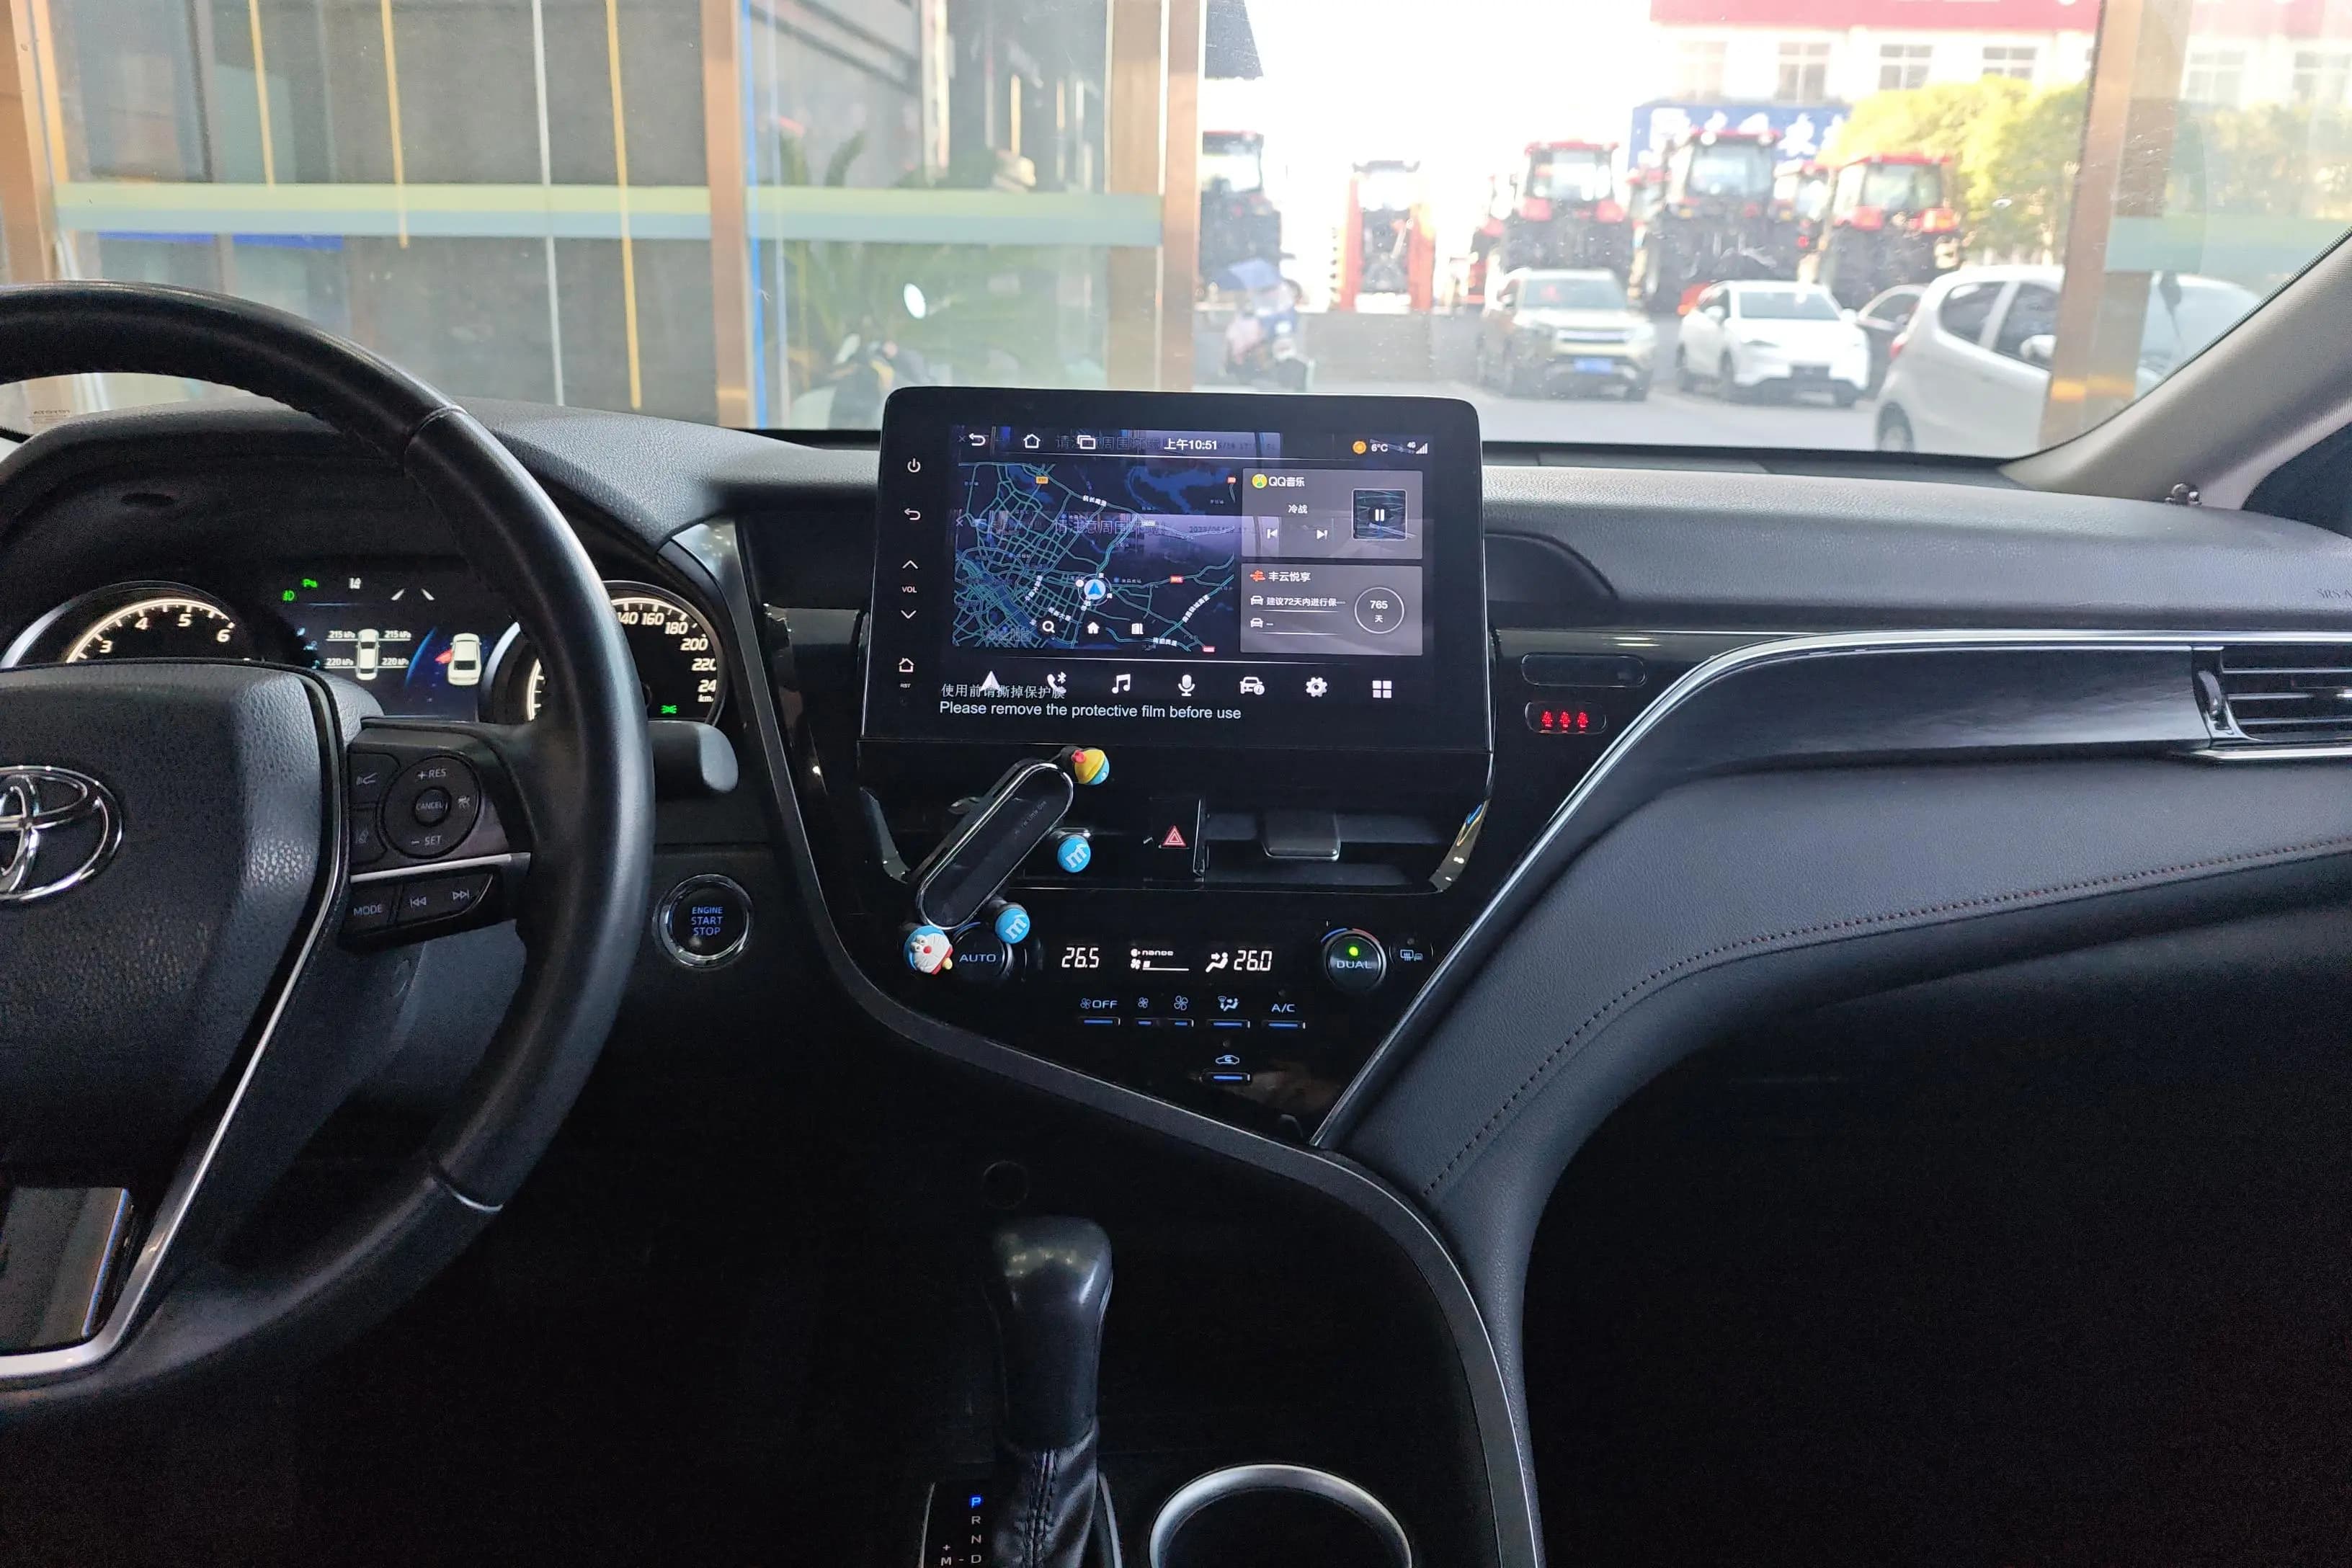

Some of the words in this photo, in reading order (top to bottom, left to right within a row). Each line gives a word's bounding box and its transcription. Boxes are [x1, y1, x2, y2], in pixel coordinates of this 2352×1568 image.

[1164, 437, 1217, 450] 上午10:51
[1268, 476, 1306, 488] QQ音乐
[1288, 504, 1308, 514] 冷战
[1268, 571, 1311, 583] 丰云悦享
[1370, 600, 1389, 610] 765
[135, 617, 149, 630] 4
[178, 613, 192, 627] 5
[641, 612, 664, 625] 160
[1374, 615, 1384, 623] 天
[664, 621, 689, 635] 180
[217, 628, 231, 643] 6
[327, 630, 343, 638] 215
[384, 630, 399, 638] 215
[99, 640, 113, 654] 3
[680, 638, 709, 651] 200
[326, 657, 342, 666] 220
[382, 657, 397, 666] 220
[698, 679, 717, 692] 24
[940, 700, 987, 714] Please
[991, 704, 1042, 715] remove
[1046, 703, 1067, 716] the
[1072, 704, 1138, 718] protective
[1141, 705, 1165, 718] film
[1170, 706, 1212, 718] before
[1217, 709, 1242, 719] use
[416, 801, 444, 810] CANCEL
[424, 835, 442, 846] SET
[1066, 843, 1090, 868] m
[353, 904, 383, 917] MODE
[690, 916, 723, 925] START
[692, 927, 721, 936] STOP
[1004, 914, 1028, 940] m
[959, 953, 997, 963] AUTO
[1061, 947, 1100, 968] 26.5
[1233, 950, 1273, 971] 26.0
[1337, 960, 1373, 969] DUAL
[1092, 999, 1118, 1009] OFF
[1270, 1003, 1296, 1013] A/C
[971, 1497, 981, 1508] P
[971, 1515, 981, 1525] R
[971, 1534, 981, 1544] N
[940, 1556, 952, 1567] M
[971, 1554, 981, 1564] D
